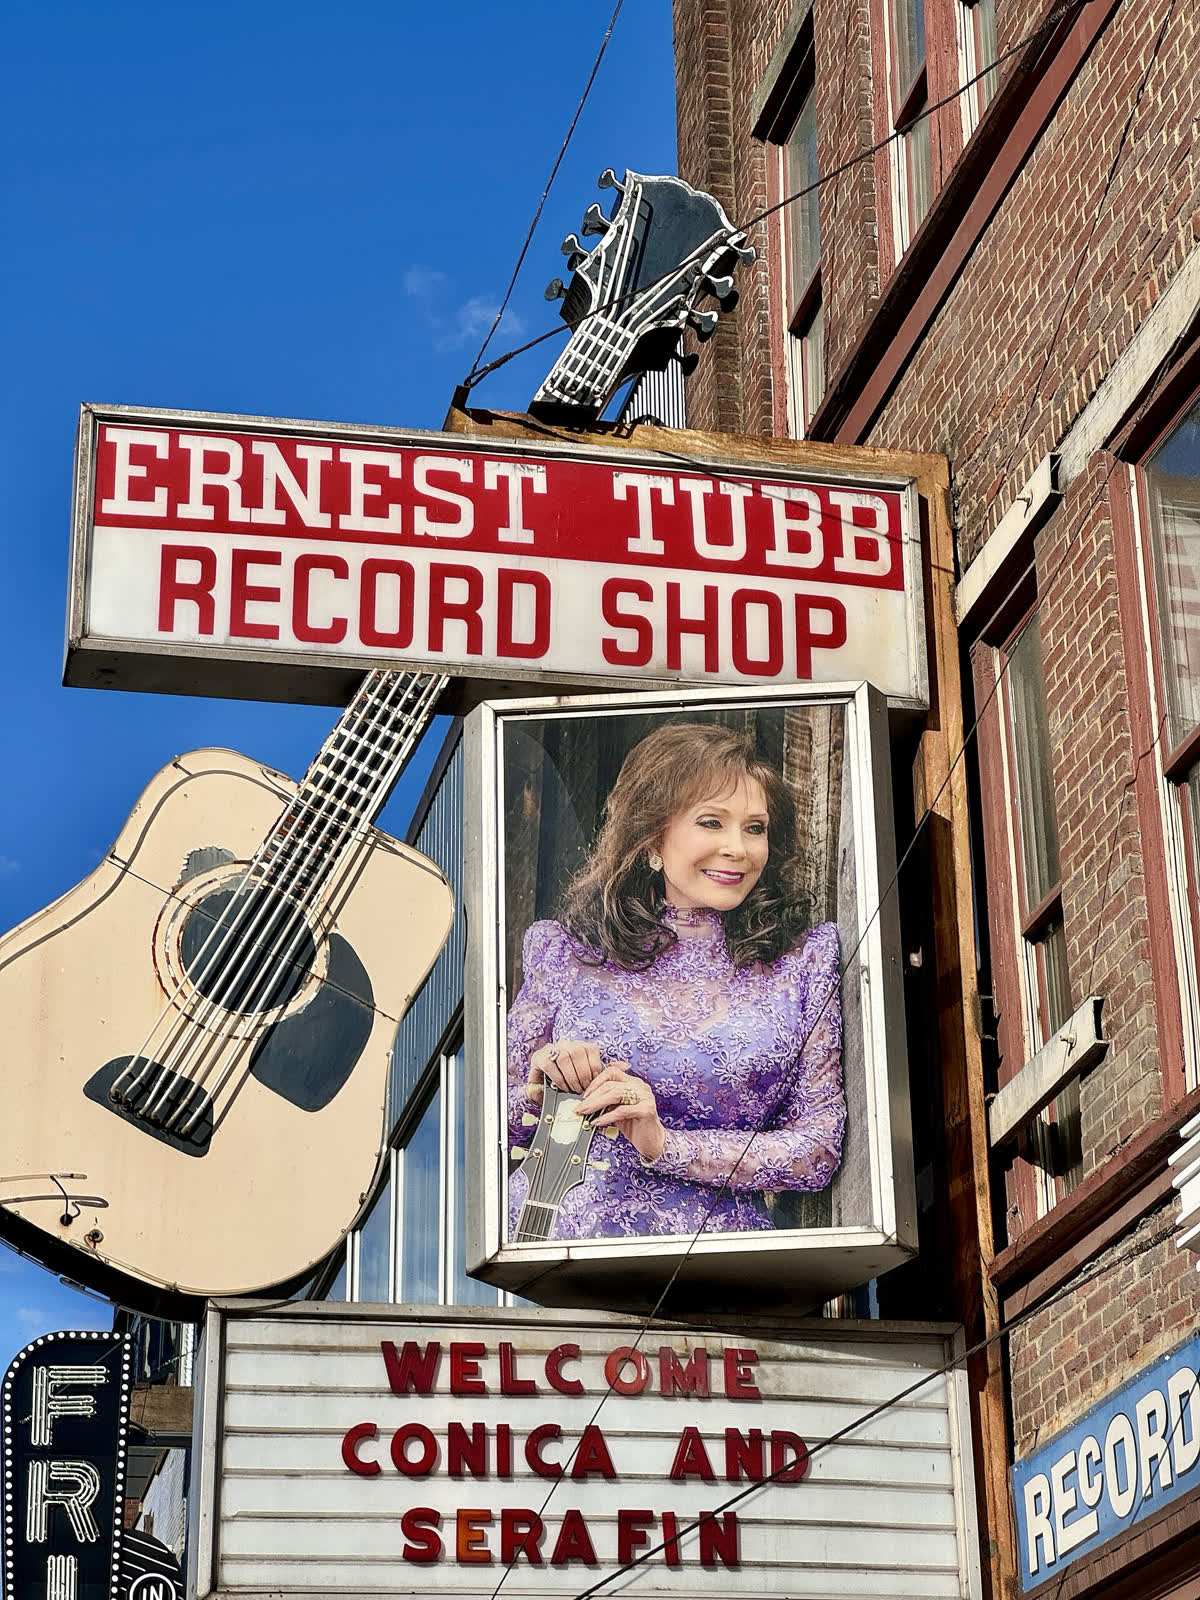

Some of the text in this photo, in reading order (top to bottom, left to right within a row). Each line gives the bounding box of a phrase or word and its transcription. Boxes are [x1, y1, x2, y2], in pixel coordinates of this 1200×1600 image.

[102, 428, 892, 576] ERNEST TUBB
[158, 544, 847, 679] RECORD SHOP
[381, 1341, 760, 1398] WELCOME
[341, 1422, 810, 1483] CONICA AND
[1023, 1366, 1200, 1576] RECORD
[401, 1507, 740, 1567] SERAFIN
